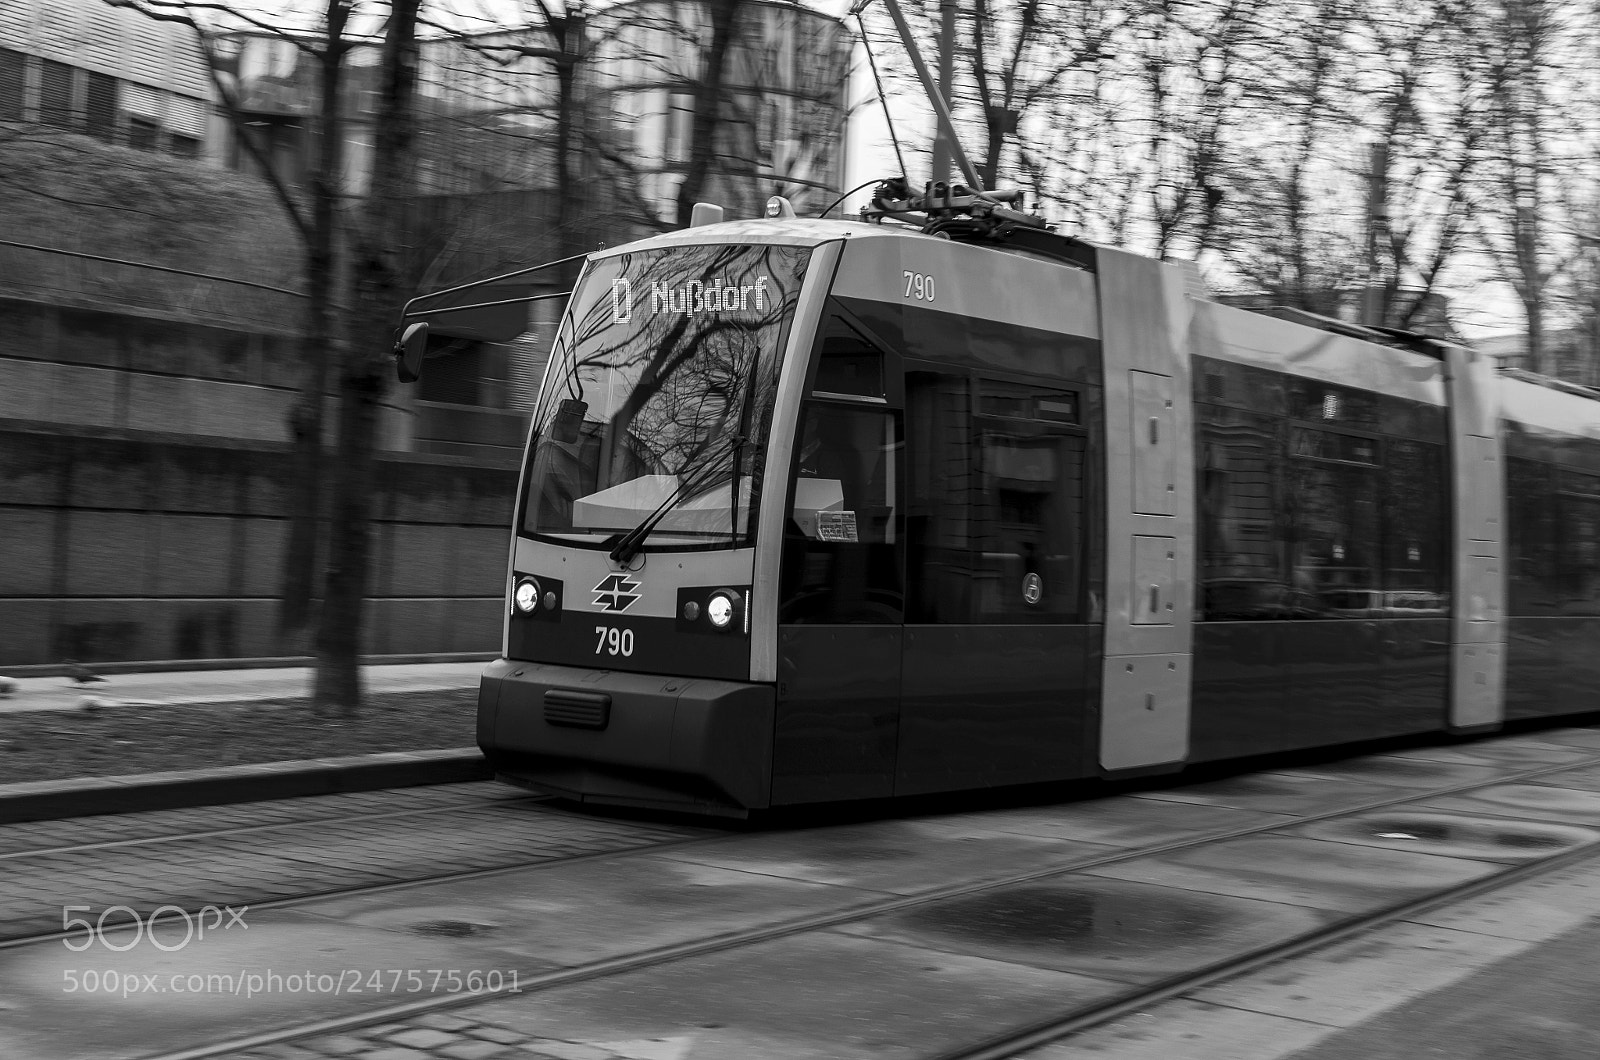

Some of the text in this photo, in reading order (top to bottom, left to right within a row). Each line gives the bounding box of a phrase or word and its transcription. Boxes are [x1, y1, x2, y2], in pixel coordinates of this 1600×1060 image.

[612, 275, 768, 325] D Nußdorf
[902, 270, 936, 303] 790
[595, 625, 635, 657] 790
